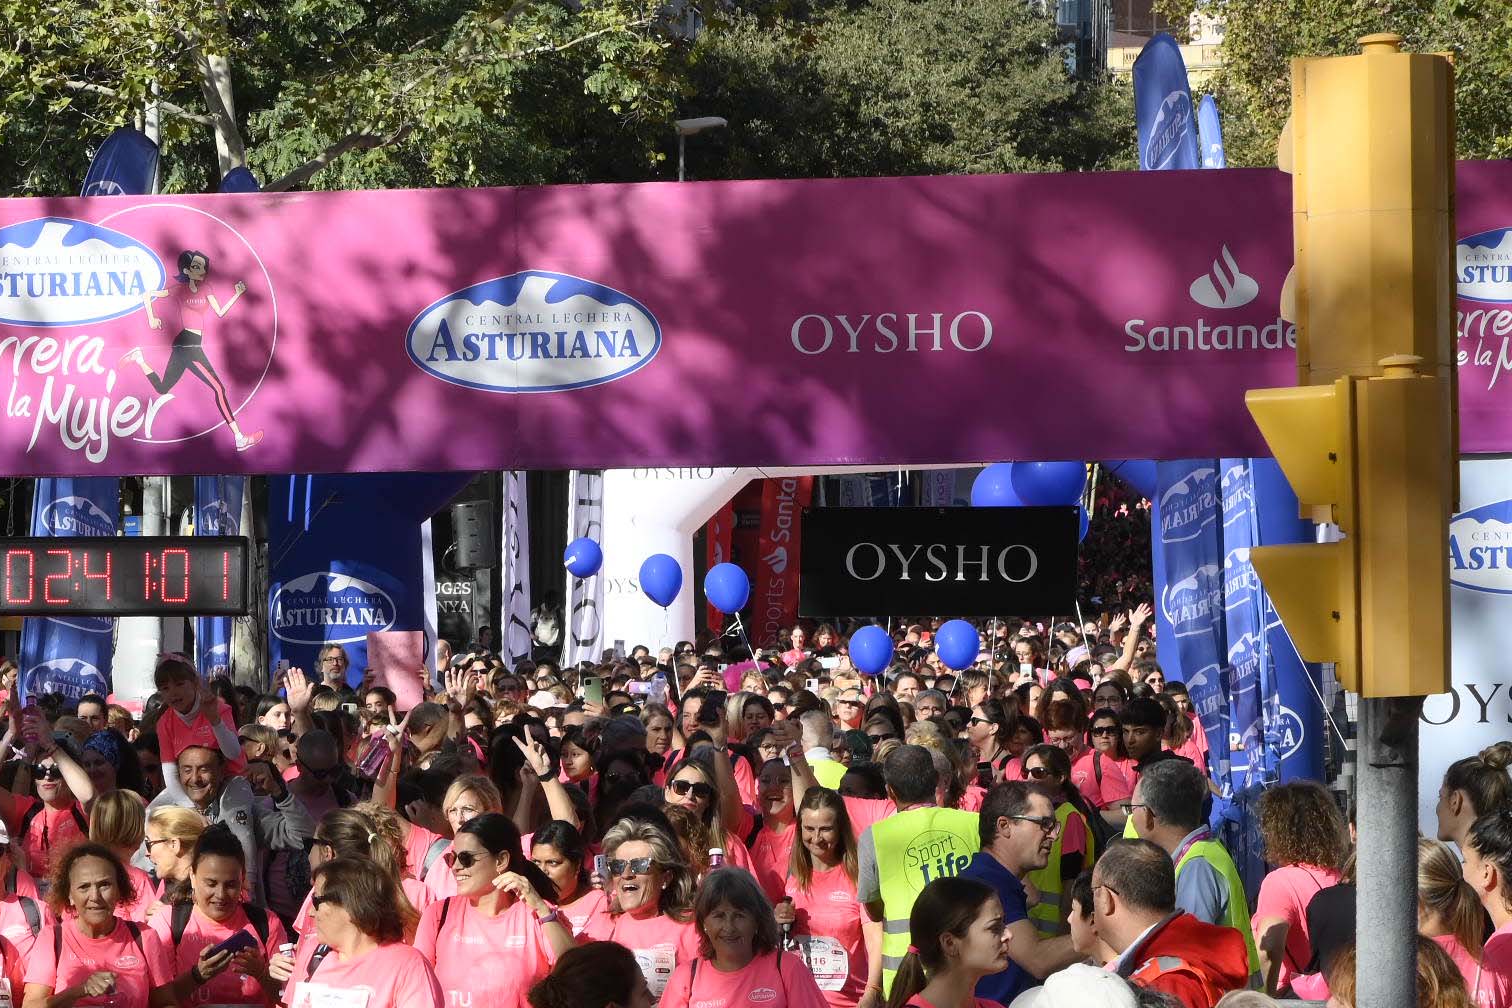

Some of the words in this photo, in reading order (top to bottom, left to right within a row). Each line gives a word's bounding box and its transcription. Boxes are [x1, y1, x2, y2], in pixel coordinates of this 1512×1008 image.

[68, 254, 143, 266] LECHERA
[465, 312, 544, 327] CENTRAL
[552, 311, 633, 325] LECHERA
[790, 311, 994, 355] OYSHO
[1124, 315, 1296, 352] Santande
[425, 318, 641, 363] ASTURIANA
[1474, 338, 1492, 367] la
[6, 376, 31, 418] la
[26, 369, 175, 464] Mujer
[845, 542, 1039, 583] OYSHO
[274, 601, 388, 629] ASTURIANA
[906, 834, 957, 868] Sport
[448, 990, 472, 1008] TU
